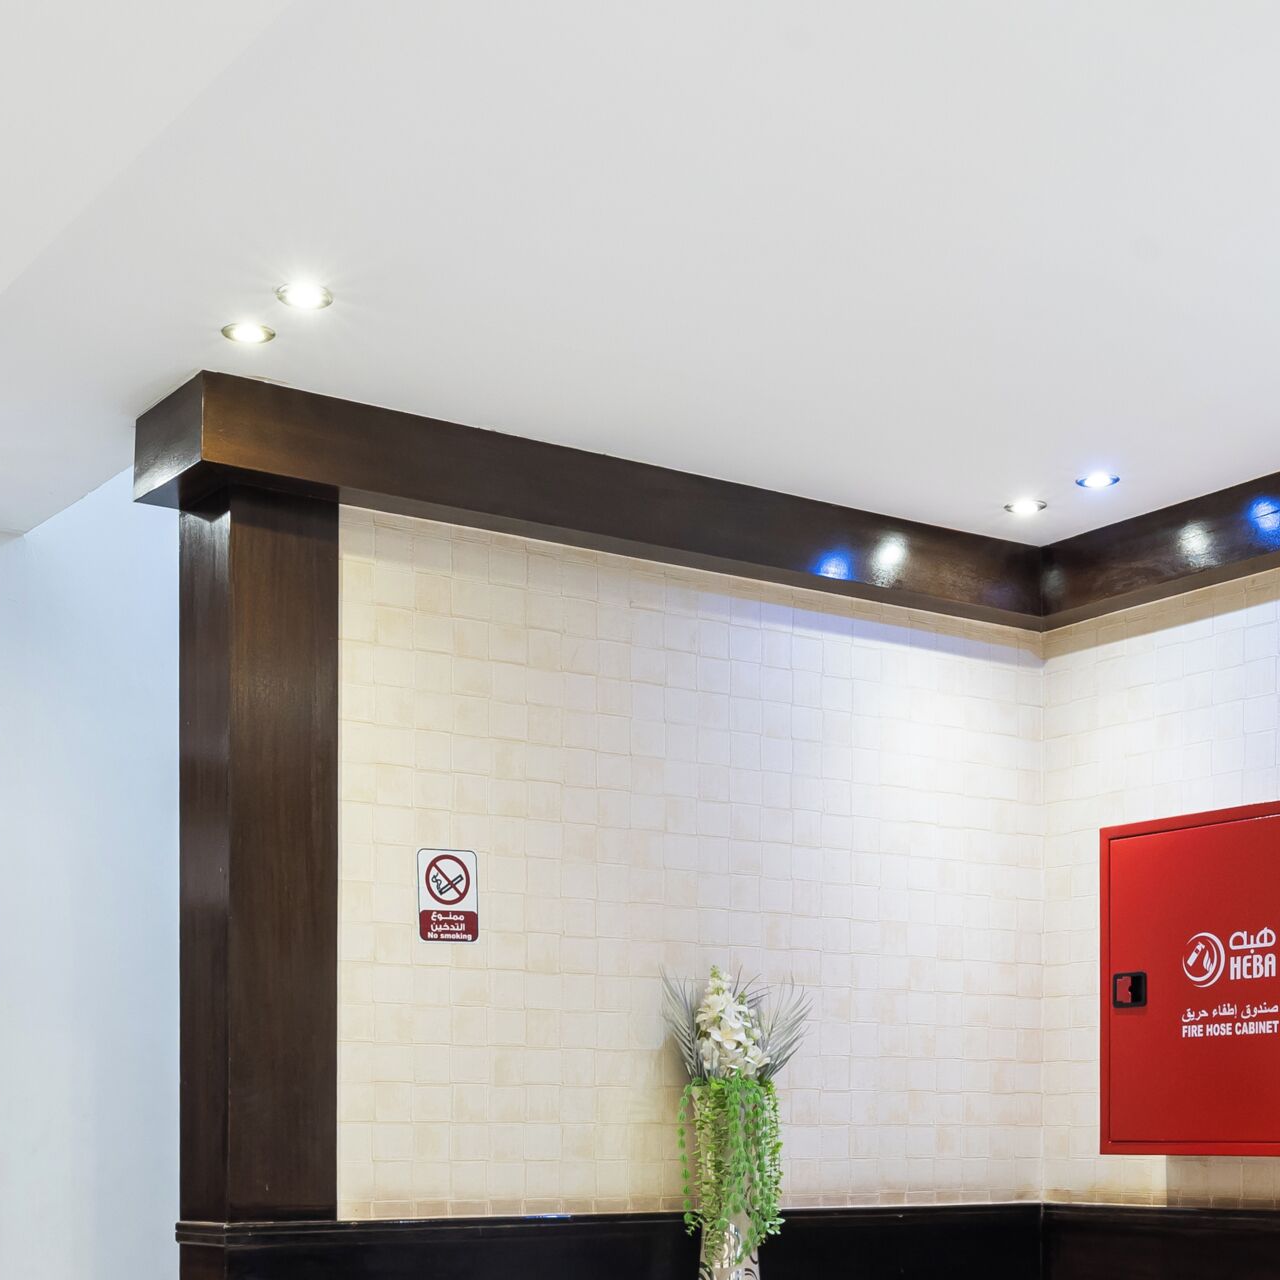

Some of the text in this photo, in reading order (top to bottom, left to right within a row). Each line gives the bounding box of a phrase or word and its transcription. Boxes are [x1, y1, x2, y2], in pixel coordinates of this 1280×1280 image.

[431, 911, 465, 921] ممنوع
[430, 922, 465, 931] التدخين
[439, 932, 472, 941] smoking
[1229, 953, 1277, 980] HEBA
[1181, 1002, 1279, 1023] صندوق إطفاء حريق
[1182, 1020, 1279, 1038] FIRE HOSE CABINET
